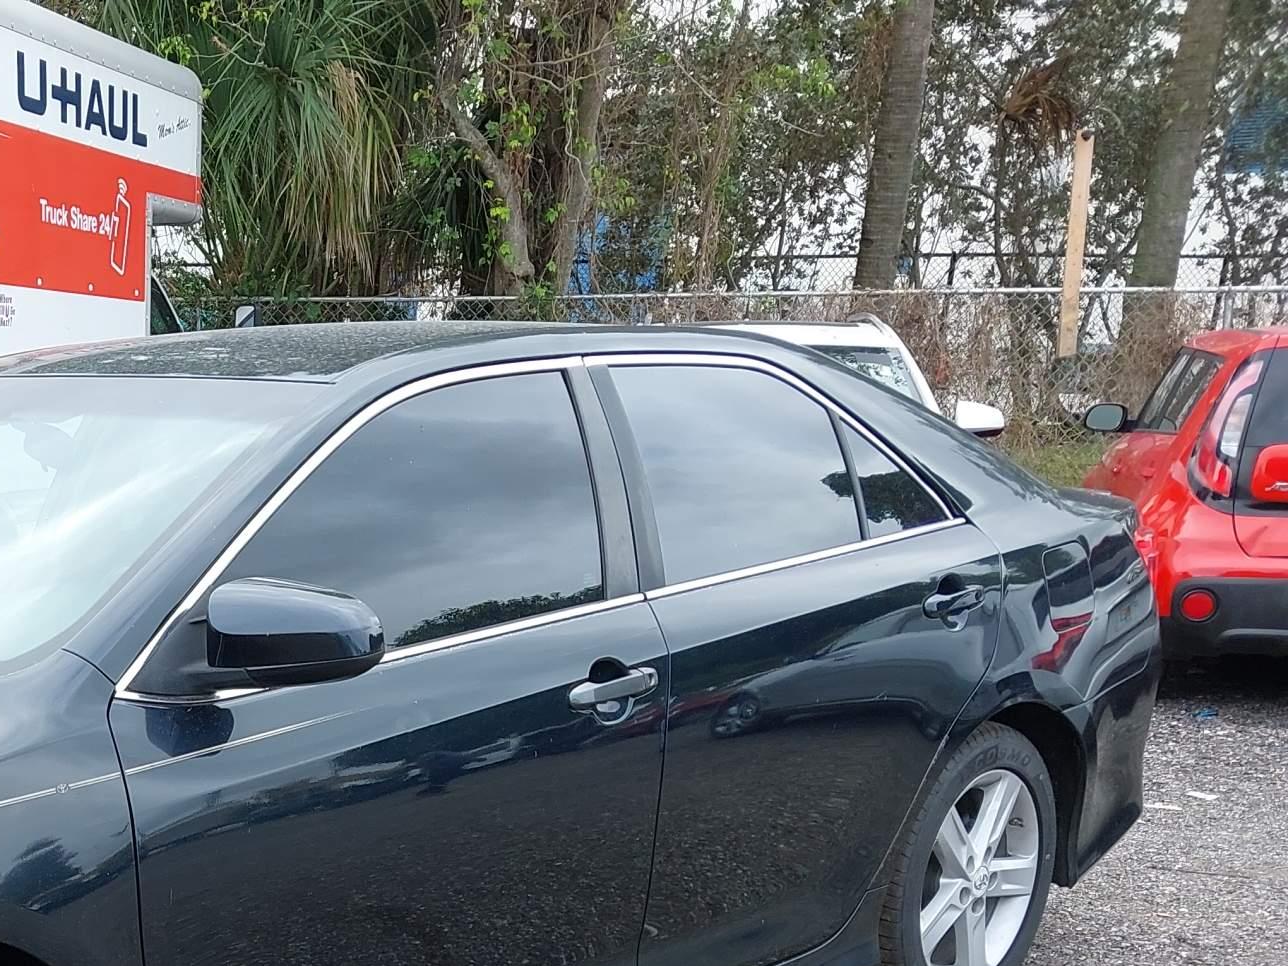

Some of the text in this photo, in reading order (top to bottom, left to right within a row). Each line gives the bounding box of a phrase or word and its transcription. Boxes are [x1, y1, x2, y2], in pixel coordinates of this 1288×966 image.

[17, 50, 147, 147] U-HAUL
[157, 123, 175, 140] Mom's
[39, 198, 120, 240] Truck Share 24/7
